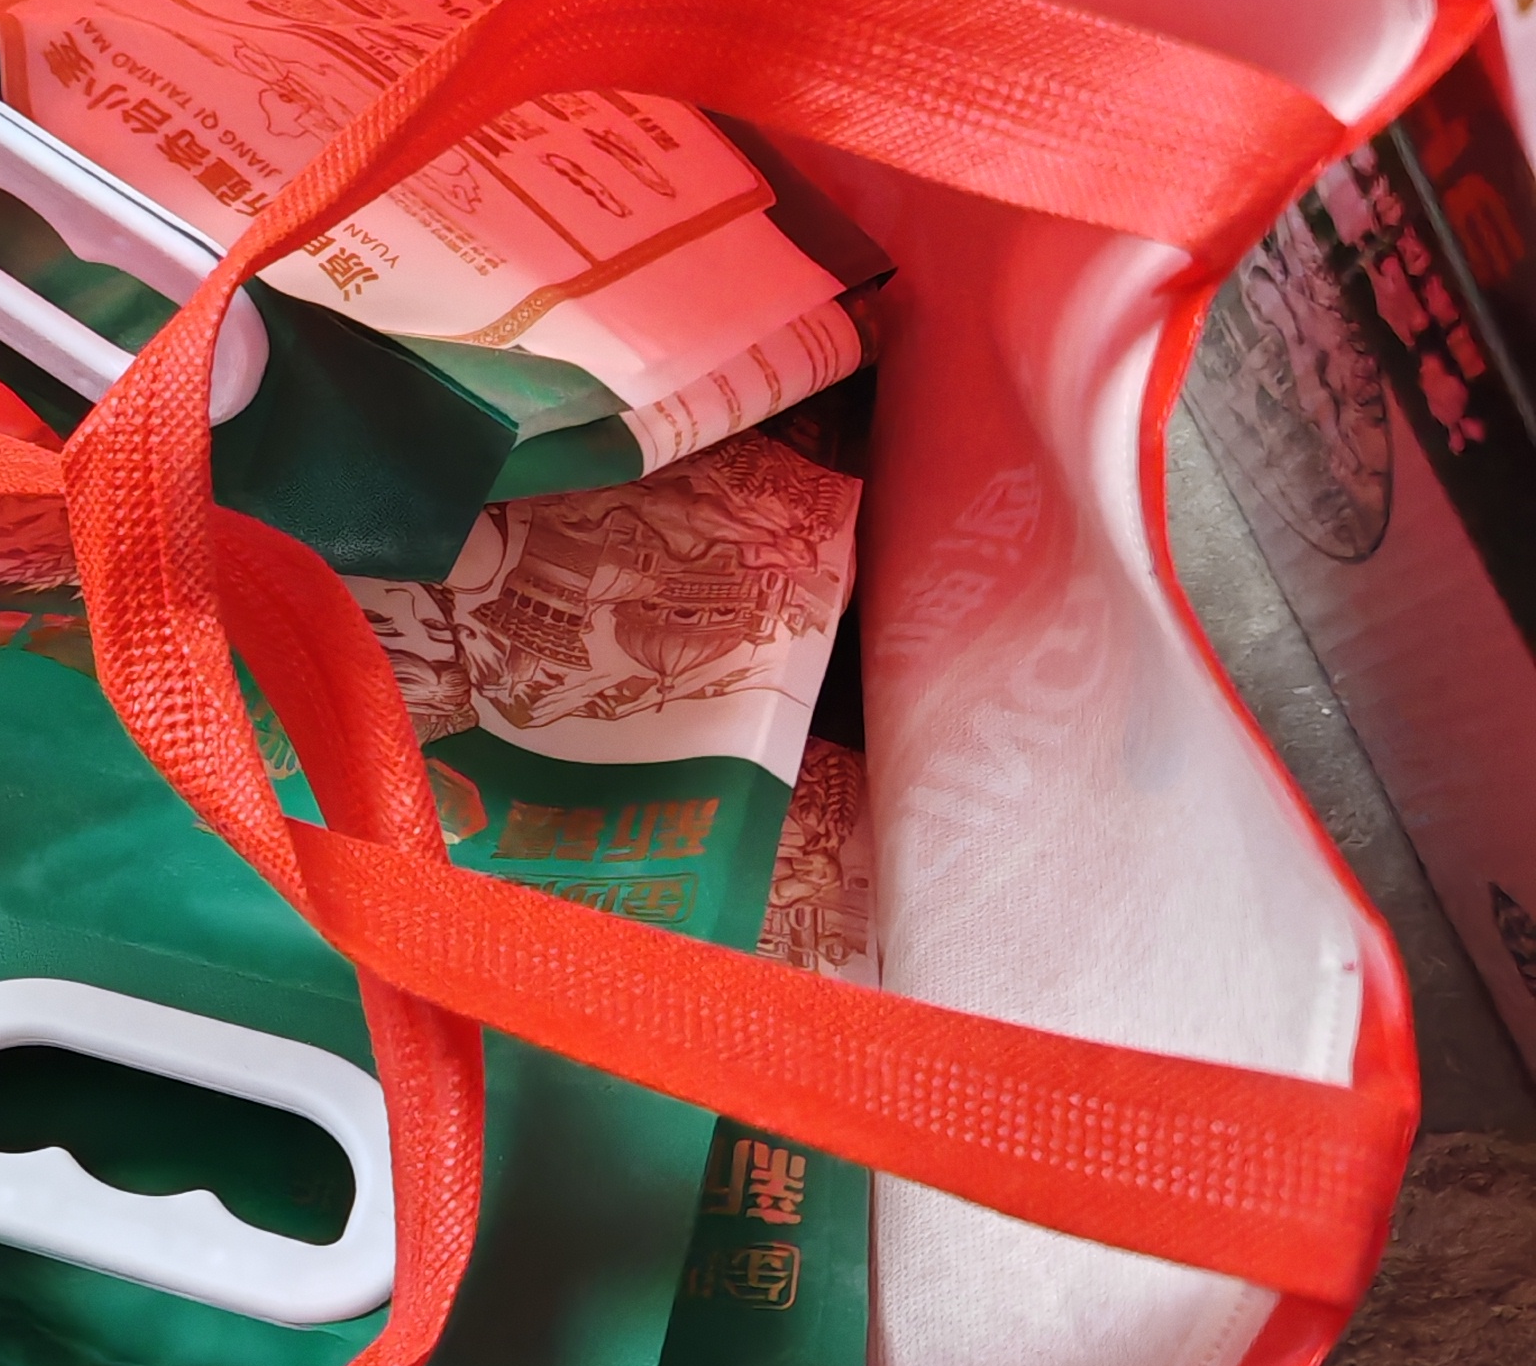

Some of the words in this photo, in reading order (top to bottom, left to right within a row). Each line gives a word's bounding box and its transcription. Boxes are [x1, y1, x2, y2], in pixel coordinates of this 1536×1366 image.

[192, 107, 220, 131] QI
[217, 129, 283, 178] JIANG
[342, 222, 400, 269] YUAN
